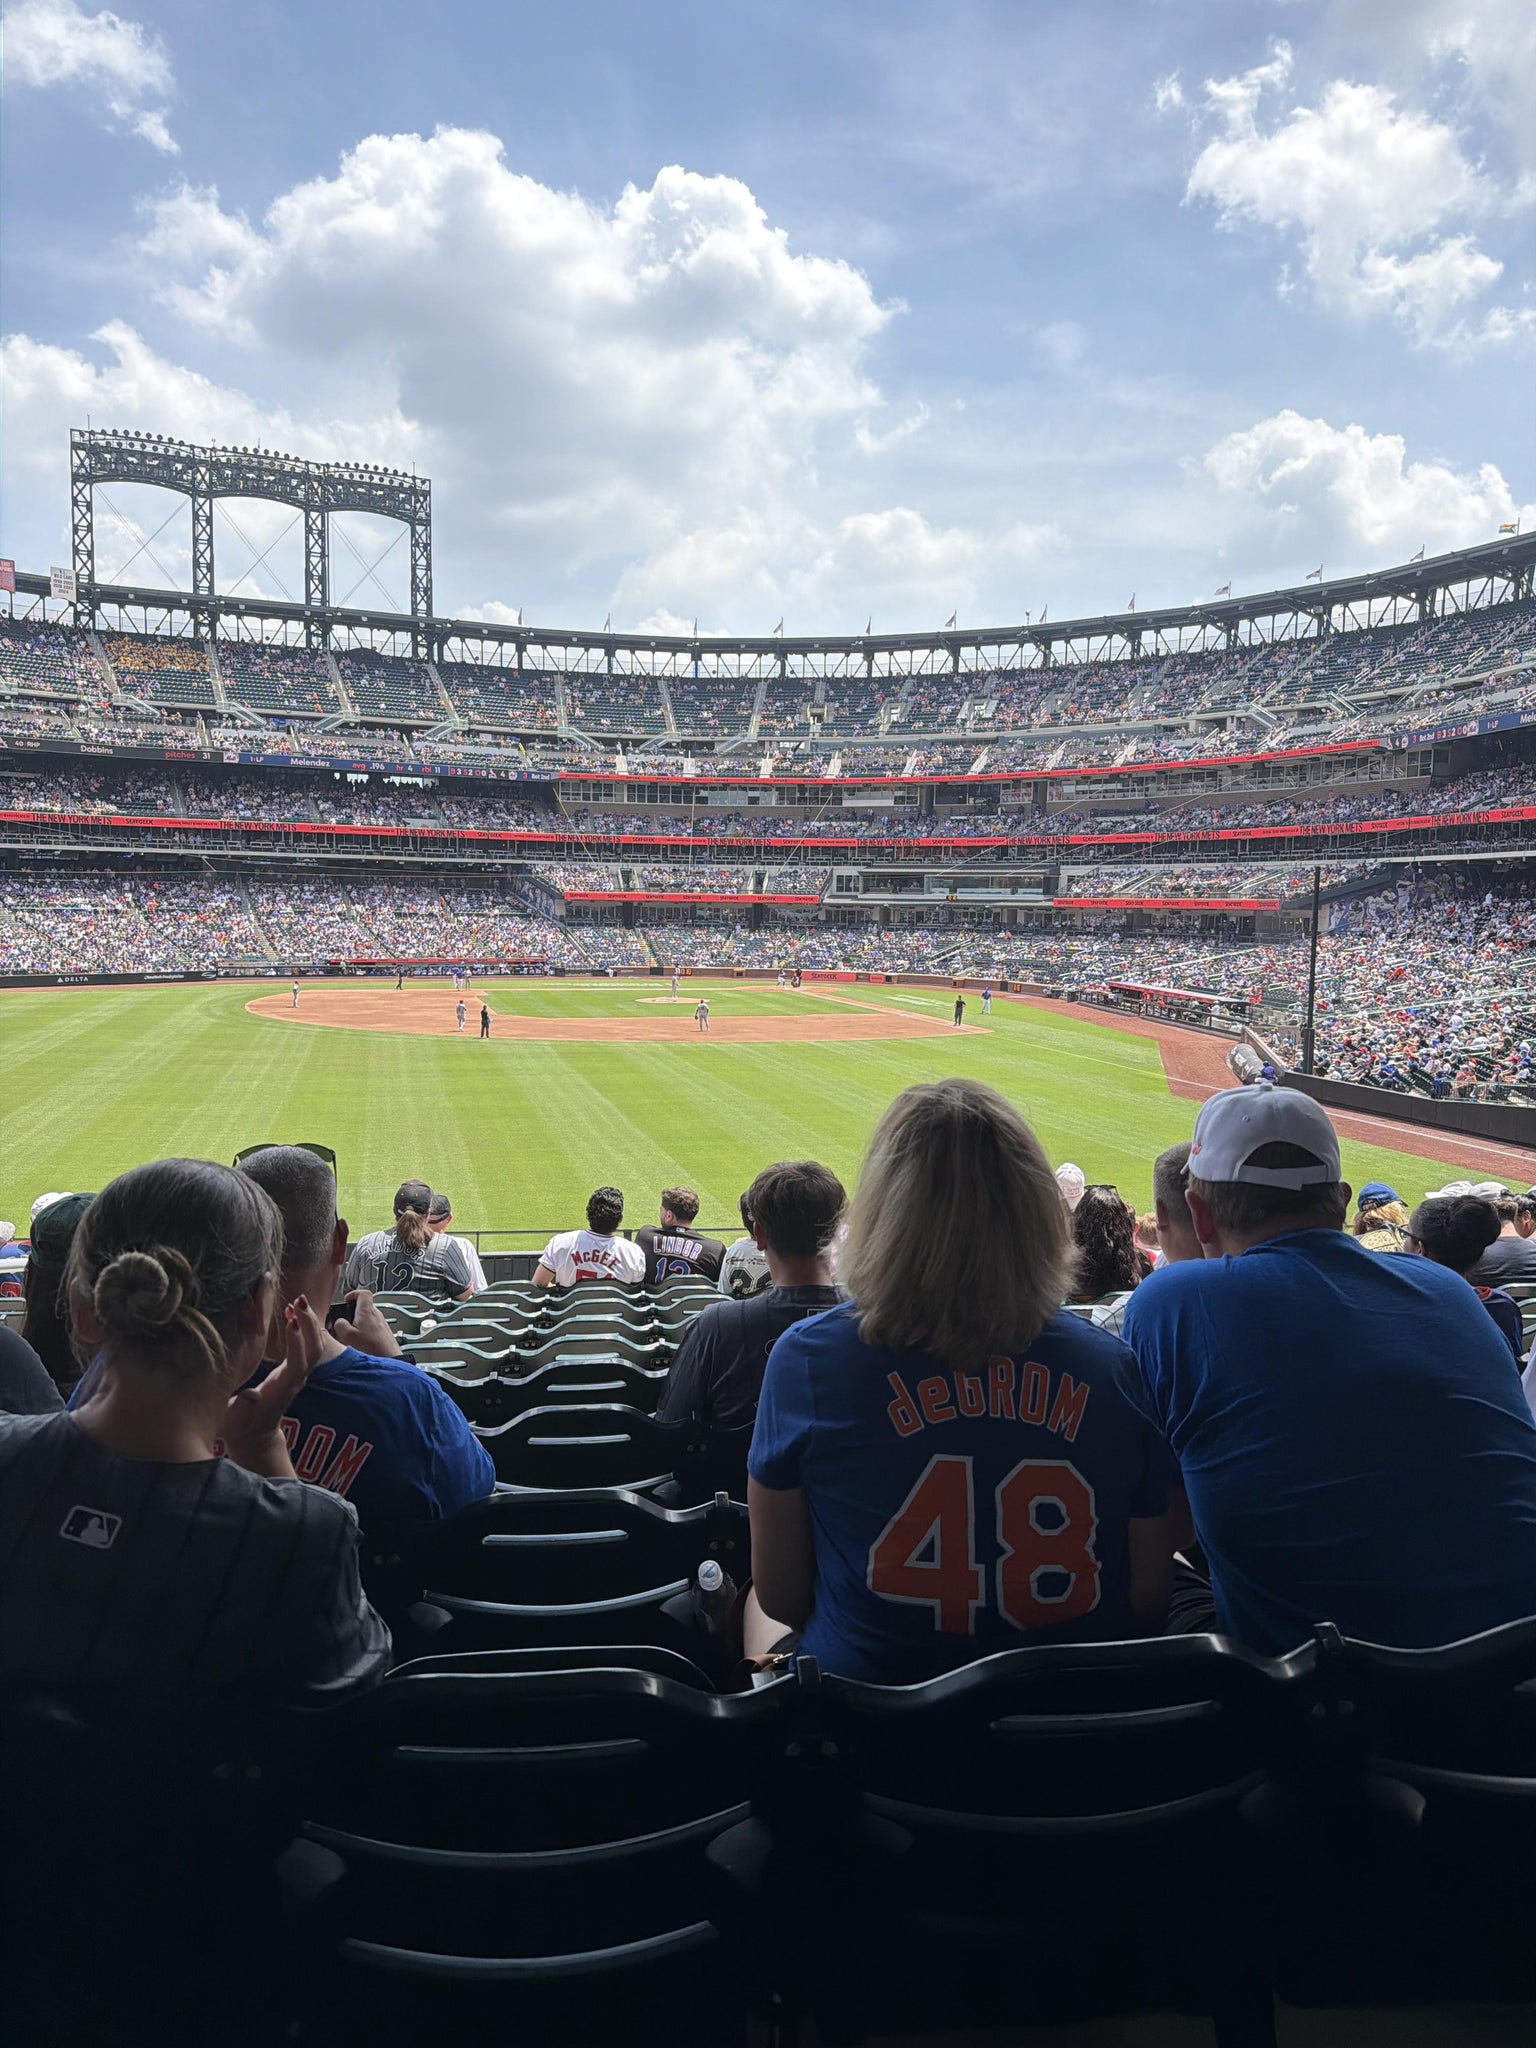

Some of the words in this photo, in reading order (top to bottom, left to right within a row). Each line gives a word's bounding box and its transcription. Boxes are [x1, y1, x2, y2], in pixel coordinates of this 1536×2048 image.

[80, 745, 113, 755] Dobbins
[165, 752, 195, 760] pitches
[202, 752, 210, 760] 31
[290, 758, 330, 767] Melendez
[370, 762, 385, 770] .196
[32, 812, 47, 822] THE
[48, 814, 66, 823] NEW
[66, 814, 90, 824] YORK
[91, 816, 112, 825] METS
[220, 821, 234, 829] THE
[235, 822, 251, 830] NEW
[252, 822, 276, 831] YORK
[276, 823, 296, 831] METS
[1301, 825, 1311, 835] THE
[1312, 825, 1326, 834] NEW
[1326, 824, 1345, 833] YORK
[1345, 823, 1362, 832] METS
[396, 828, 408, 836] THE
[410, 829, 426, 837] NEW
[427, 830, 446, 838] YORK
[447, 830, 465, 838] METS
[1155, 833, 1168, 841] THE
[1168, 833, 1183, 841] NEW
[1183, 832, 1200, 840] YORK
[1200, 831, 1220, 840] METS
[366, 1240, 425, 1260] LINDOR
[653, 1236, 703, 1260] LINDOR
[571, 1249, 621, 1271] McGEE
[372, 1260, 414, 1291] 12
[655, 1257, 691, 1283] 12
[887, 1355, 1089, 1442] deGROM
[866, 1454, 1102, 1636] 48
